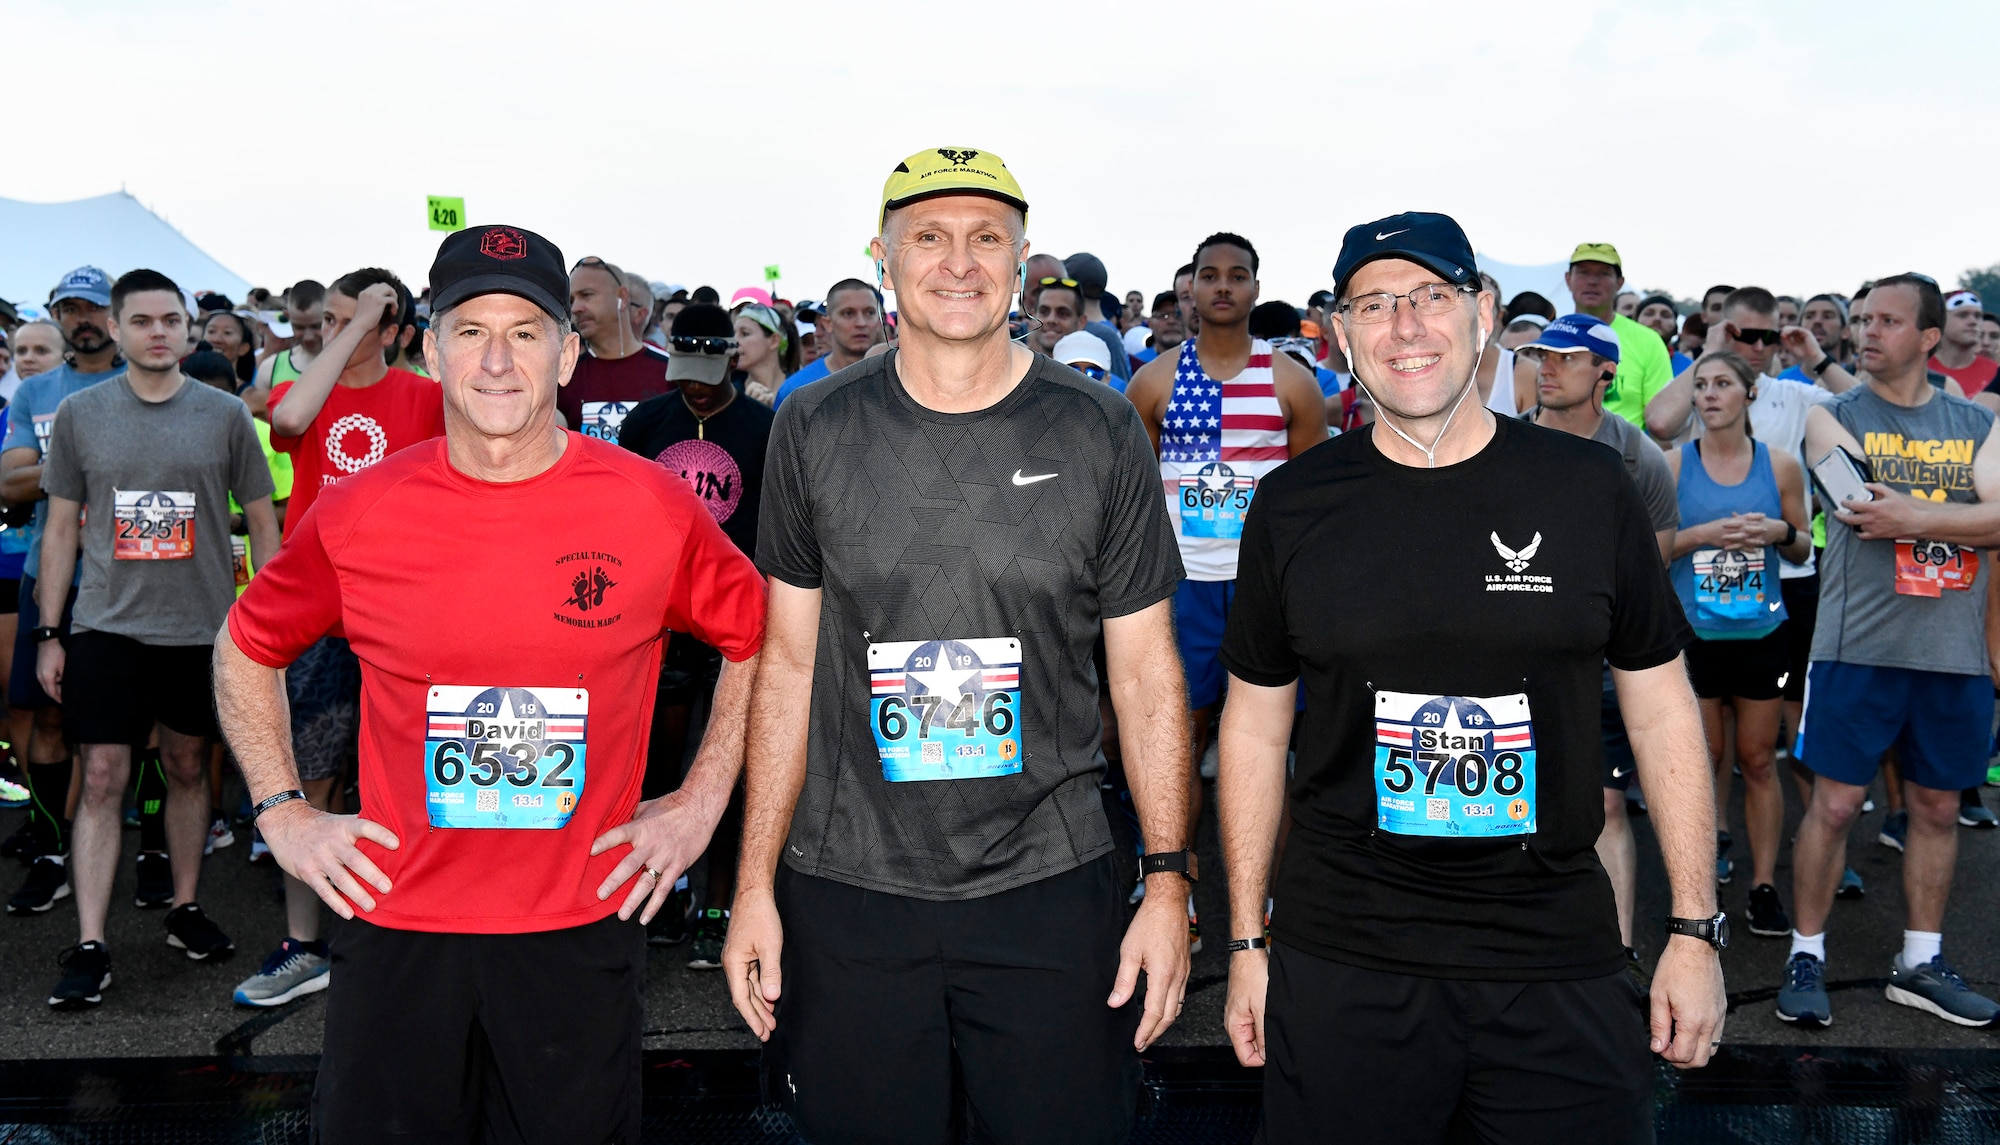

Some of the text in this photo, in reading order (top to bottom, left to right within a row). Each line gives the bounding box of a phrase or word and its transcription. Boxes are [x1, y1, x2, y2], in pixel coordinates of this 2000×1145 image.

[960, 168, 997, 180] MARATHON
[434, 208, 457, 226] 4:20
[1184, 488, 1248, 510] 6675
[120, 519, 187, 540] 2251
[556, 552, 622, 567] SPECIAL TACTICS
[1912, 544, 1963, 569] 691
[1486, 584, 1553, 593] AIRFORCE.COM
[1700, 572, 1762, 594] 4214
[554, 612, 622, 628] MEMORIAL MARCH
[915, 655, 972, 668] 20 19
[477, 702, 537, 714] 20 19
[878, 692, 1014, 741] 6746
[1422, 712, 1484, 725] 20 19
[468, 720, 542, 740] David
[1420, 729, 1484, 750] Stan
[956, 744, 986, 758] 13.1
[434, 741, 575, 788] 6532
[1384, 749, 1524, 797] 5708
[513, 795, 544, 807] 13.1
[1381, 802, 1414, 812] MARATHON
[1393, 798, 1414, 806] FORCE
[1514, 804, 1522, 812] B
[1463, 804, 1494, 816] 13.1
